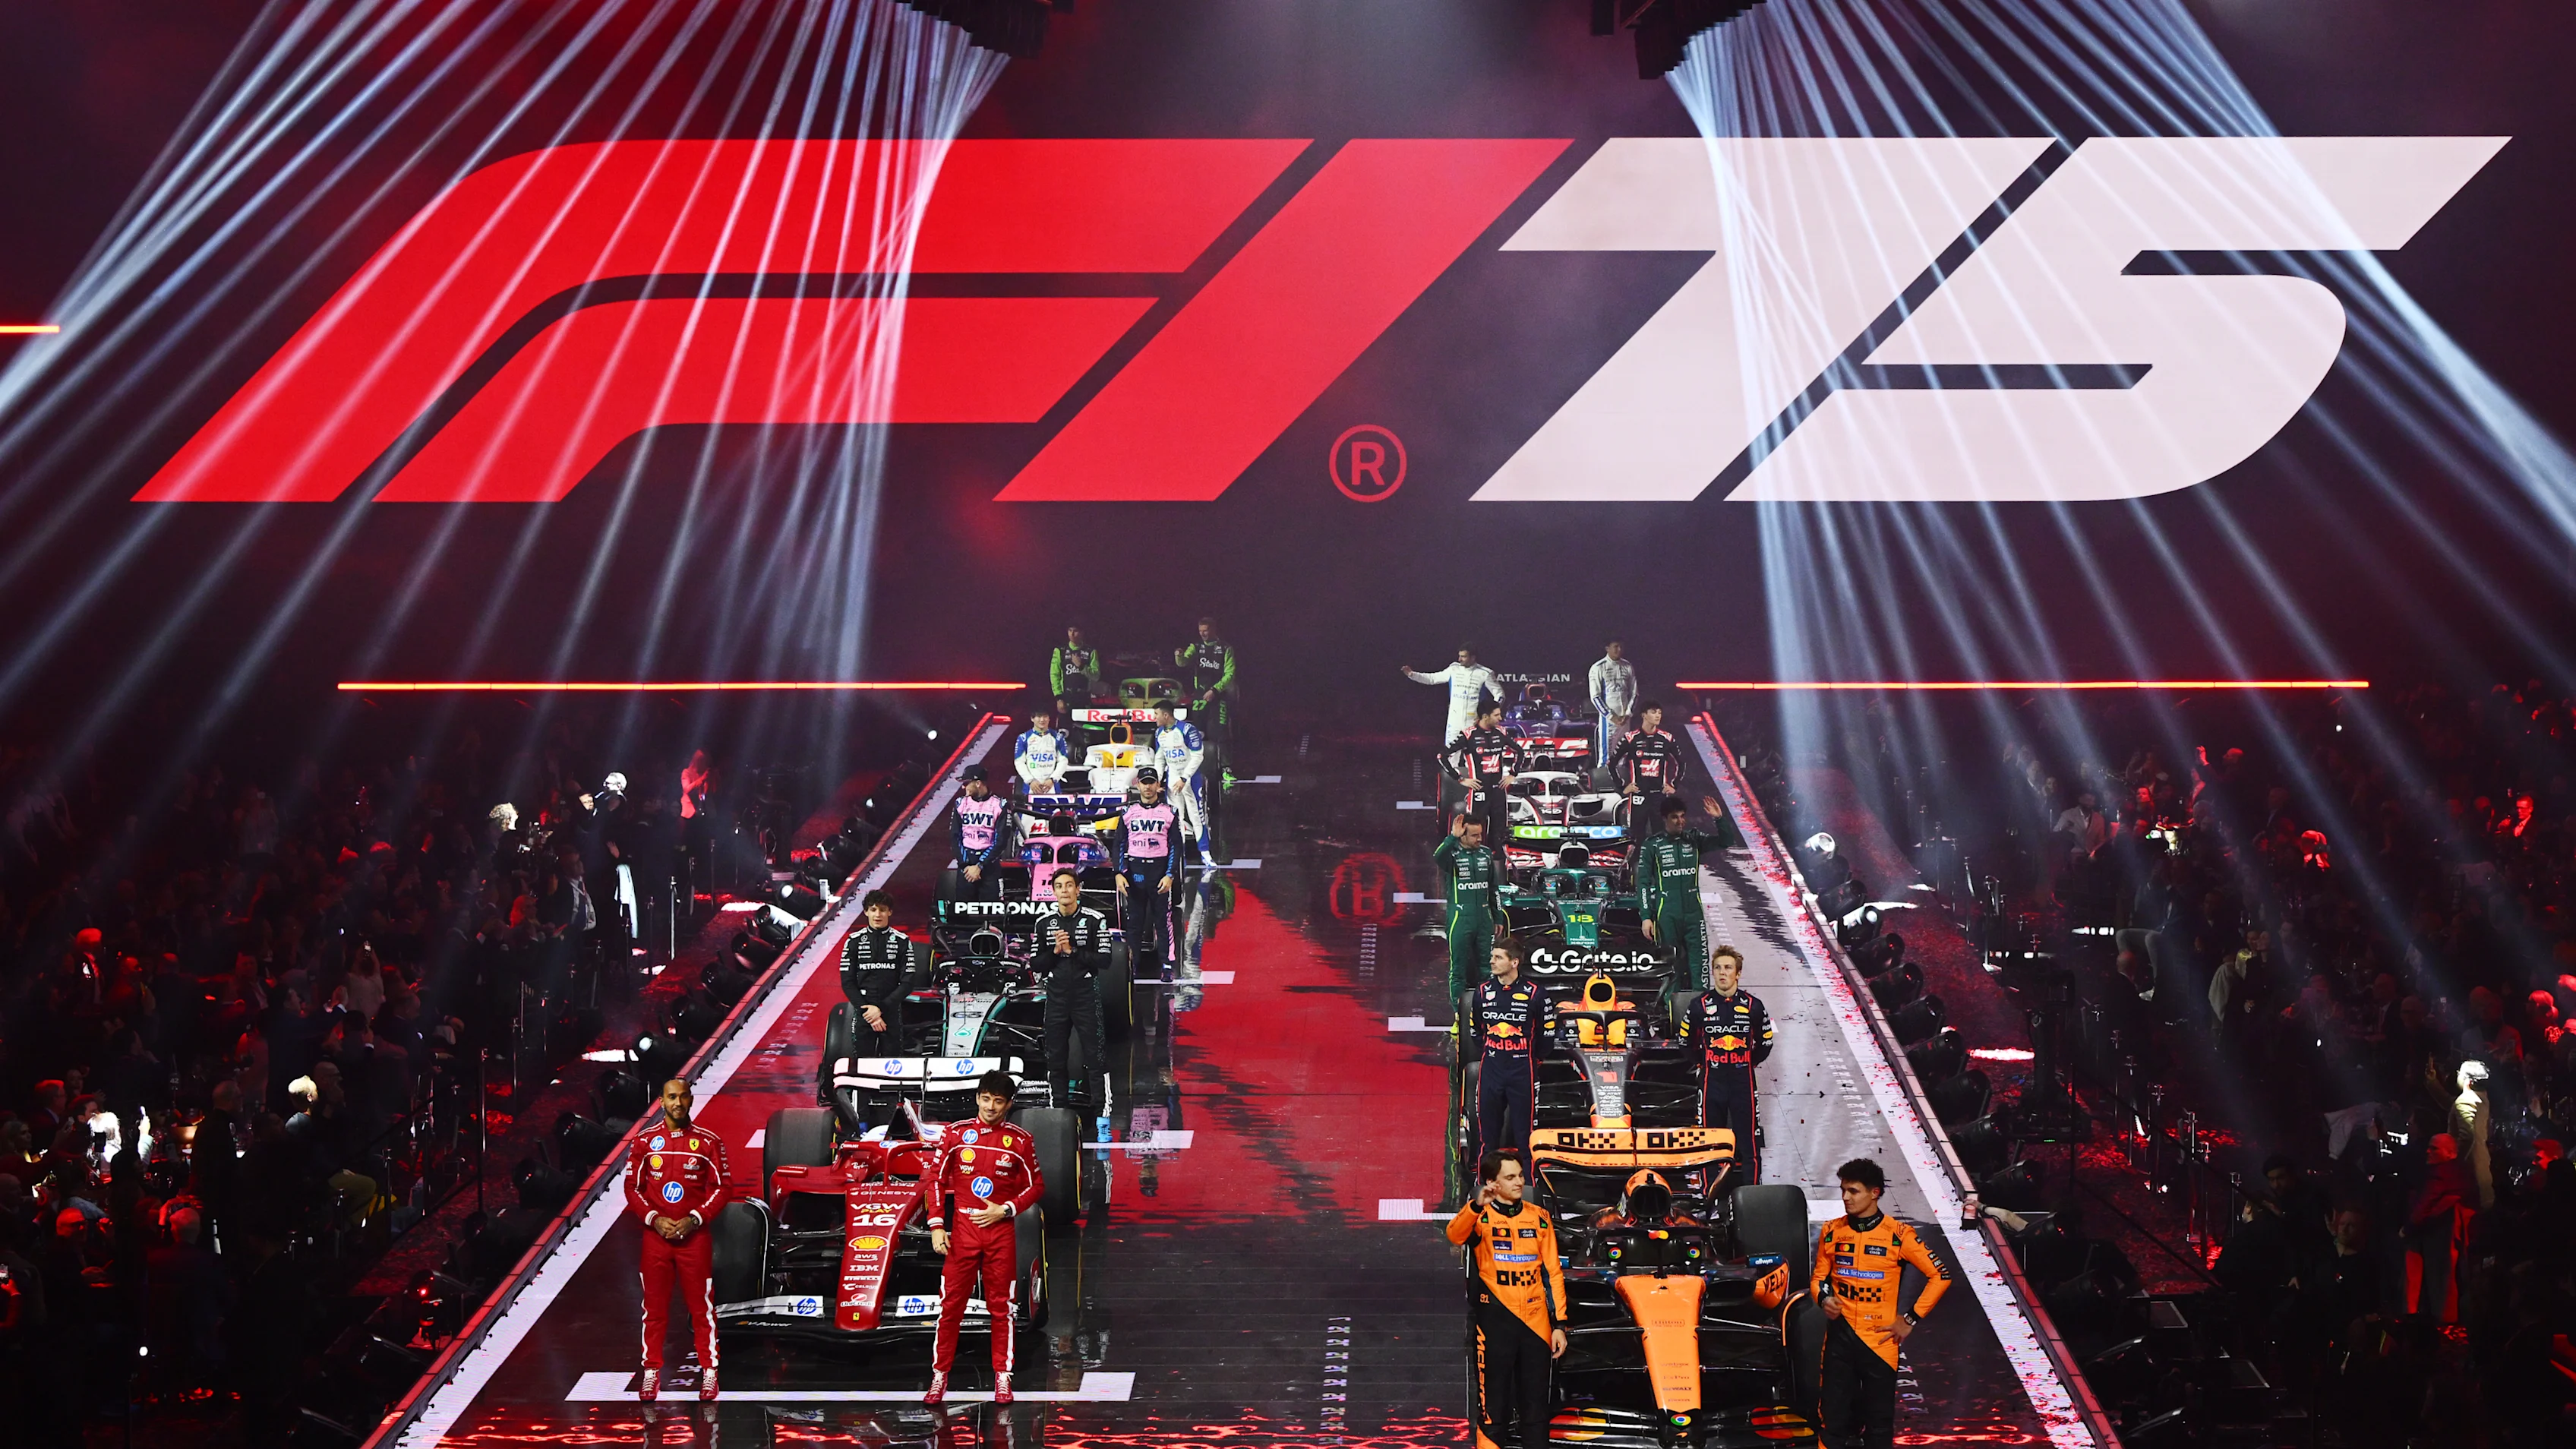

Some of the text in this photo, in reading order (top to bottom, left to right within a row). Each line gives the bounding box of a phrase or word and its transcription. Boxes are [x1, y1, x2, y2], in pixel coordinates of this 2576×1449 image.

[1470, 135, 2512, 502] 75
[1200, 658, 1220, 669] Stake
[1497, 674, 1571, 683] ATLASIAN
[1192, 699, 1207, 711] 27
[1031, 753, 1053, 762] VISA
[1474, 792, 1485, 801] 31
[1632, 796, 1645, 805] 87
[962, 813, 993, 827] BWT
[1130, 819, 1165, 832] BWT
[1132, 838, 1146, 847] eni
[1662, 867, 1696, 877] aramco
[1457, 881, 1488, 890] aramco
[955, 901, 1059, 915] PETRONAS
[1567, 914, 1594, 923] 18
[1559, 949, 1656, 973] Gate.io
[1482, 1012, 1527, 1021] ORACLE
[1505, 1037, 1528, 1051] Bull
[1706, 1050, 1750, 1063] Red Bull
[886, 1059, 902, 1075] hp
[957, 1059, 974, 1075] hp
[1596, 1072, 1618, 1083] 1
[651, 1136, 665, 1151] hp
[963, 1129, 977, 1144] hp
[1558, 1132, 1616, 1149] OKX
[1647, 1131, 1706, 1148] OKX
[663, 1182, 683, 1203] hp
[972, 1176, 993, 1198] hp
[852, 1214, 896, 1226] 16
[1497, 1270, 1537, 1286] OKX
[1763, 1269, 1785, 1293] VELO
[1851, 1270, 1883, 1279] Technologies
[1838, 1281, 1882, 1302] OKX
[797, 1298, 816, 1315] hp
[904, 1297, 924, 1314] hp
